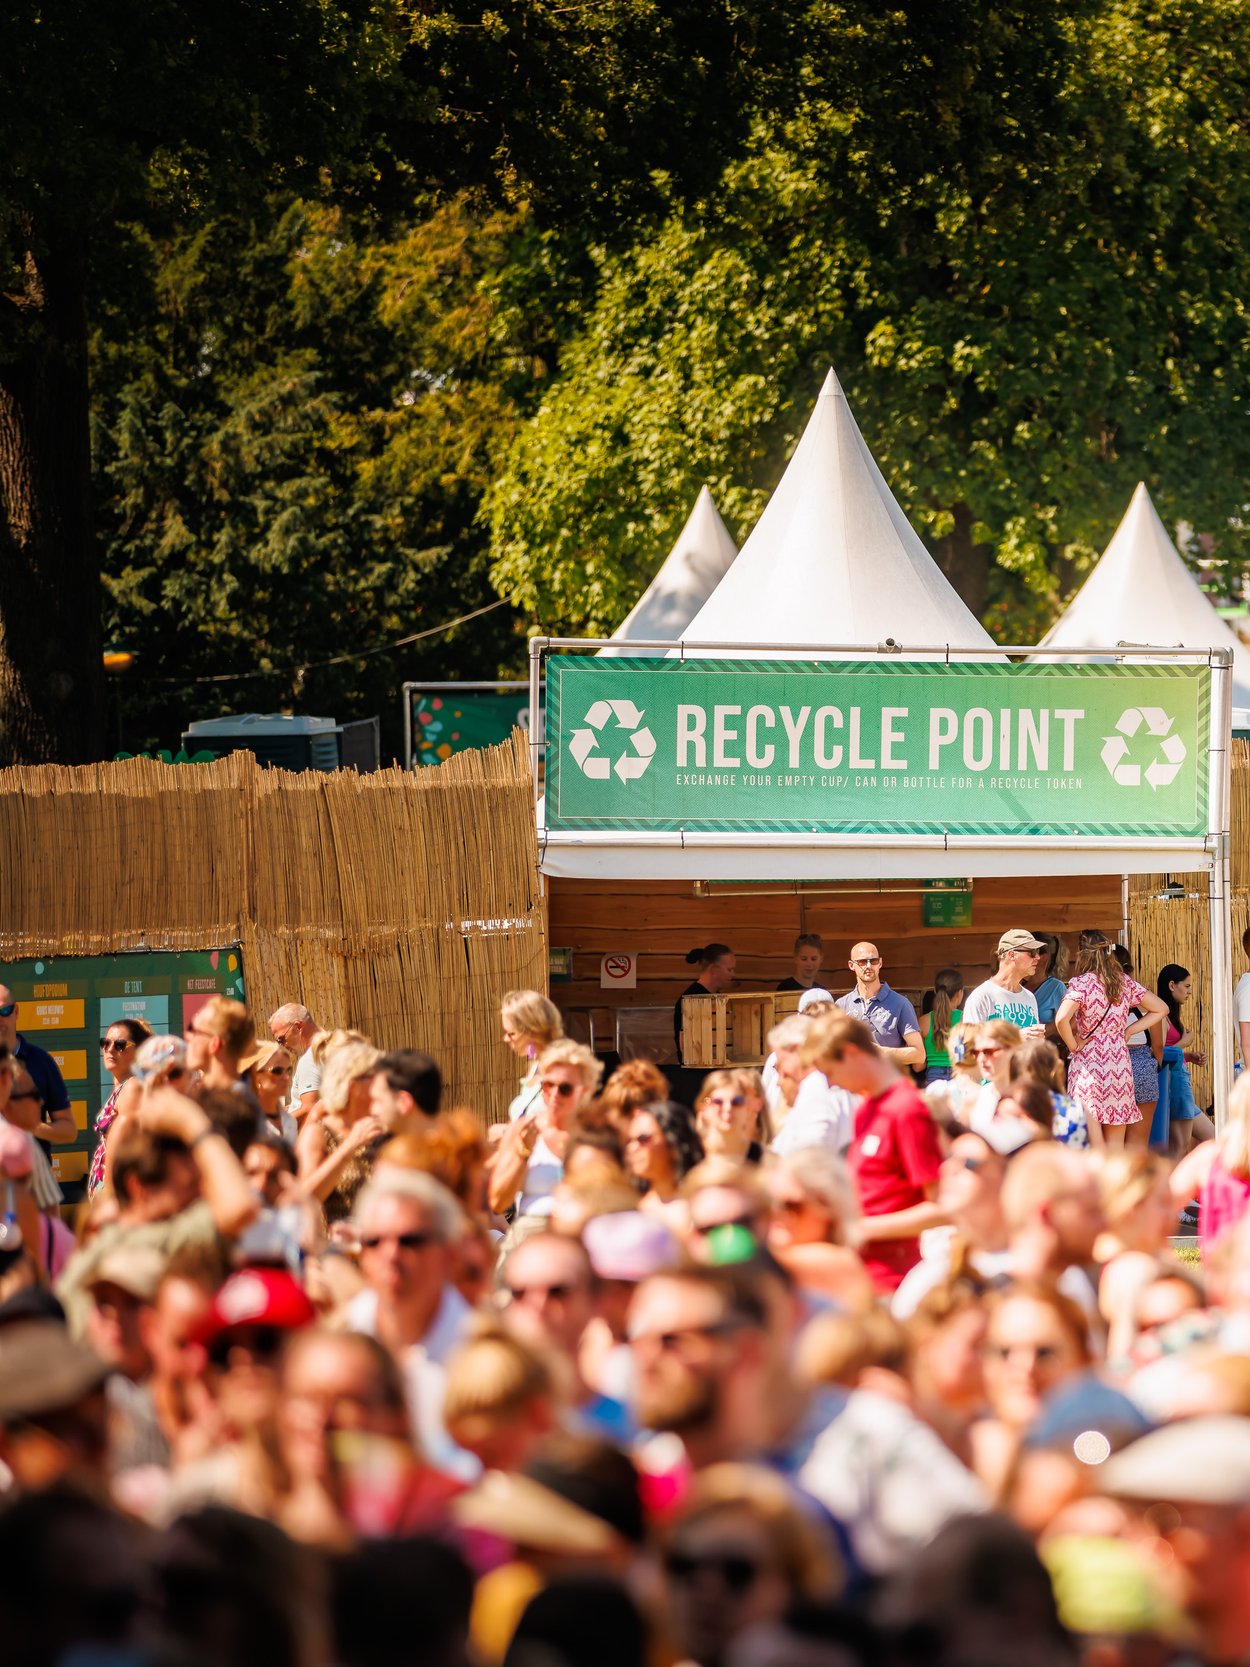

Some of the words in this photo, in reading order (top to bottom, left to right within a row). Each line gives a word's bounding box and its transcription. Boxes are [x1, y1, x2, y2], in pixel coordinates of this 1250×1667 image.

[676, 704, 909, 770] RECYCLE
[928, 707, 1085, 772] POINT
[676, 774, 736, 786] EXCHANGE
[743, 775, 771, 786] YOUR
[777, 776, 815, 787] EMPTY
[821, 776, 849, 788] CUP/
[855, 776, 877, 788] CAN
[883, 777, 897, 788] OR
[903, 777, 945, 788] BOTTLE
[951, 778, 972, 789] FOR
[978, 778, 985, 789] A
[990, 778, 1040, 789] RECYCLE
[1047, 778, 1082, 789] TOKEN
[125, 982, 131, 993] DE
[131, 981, 143, 993] TENT
